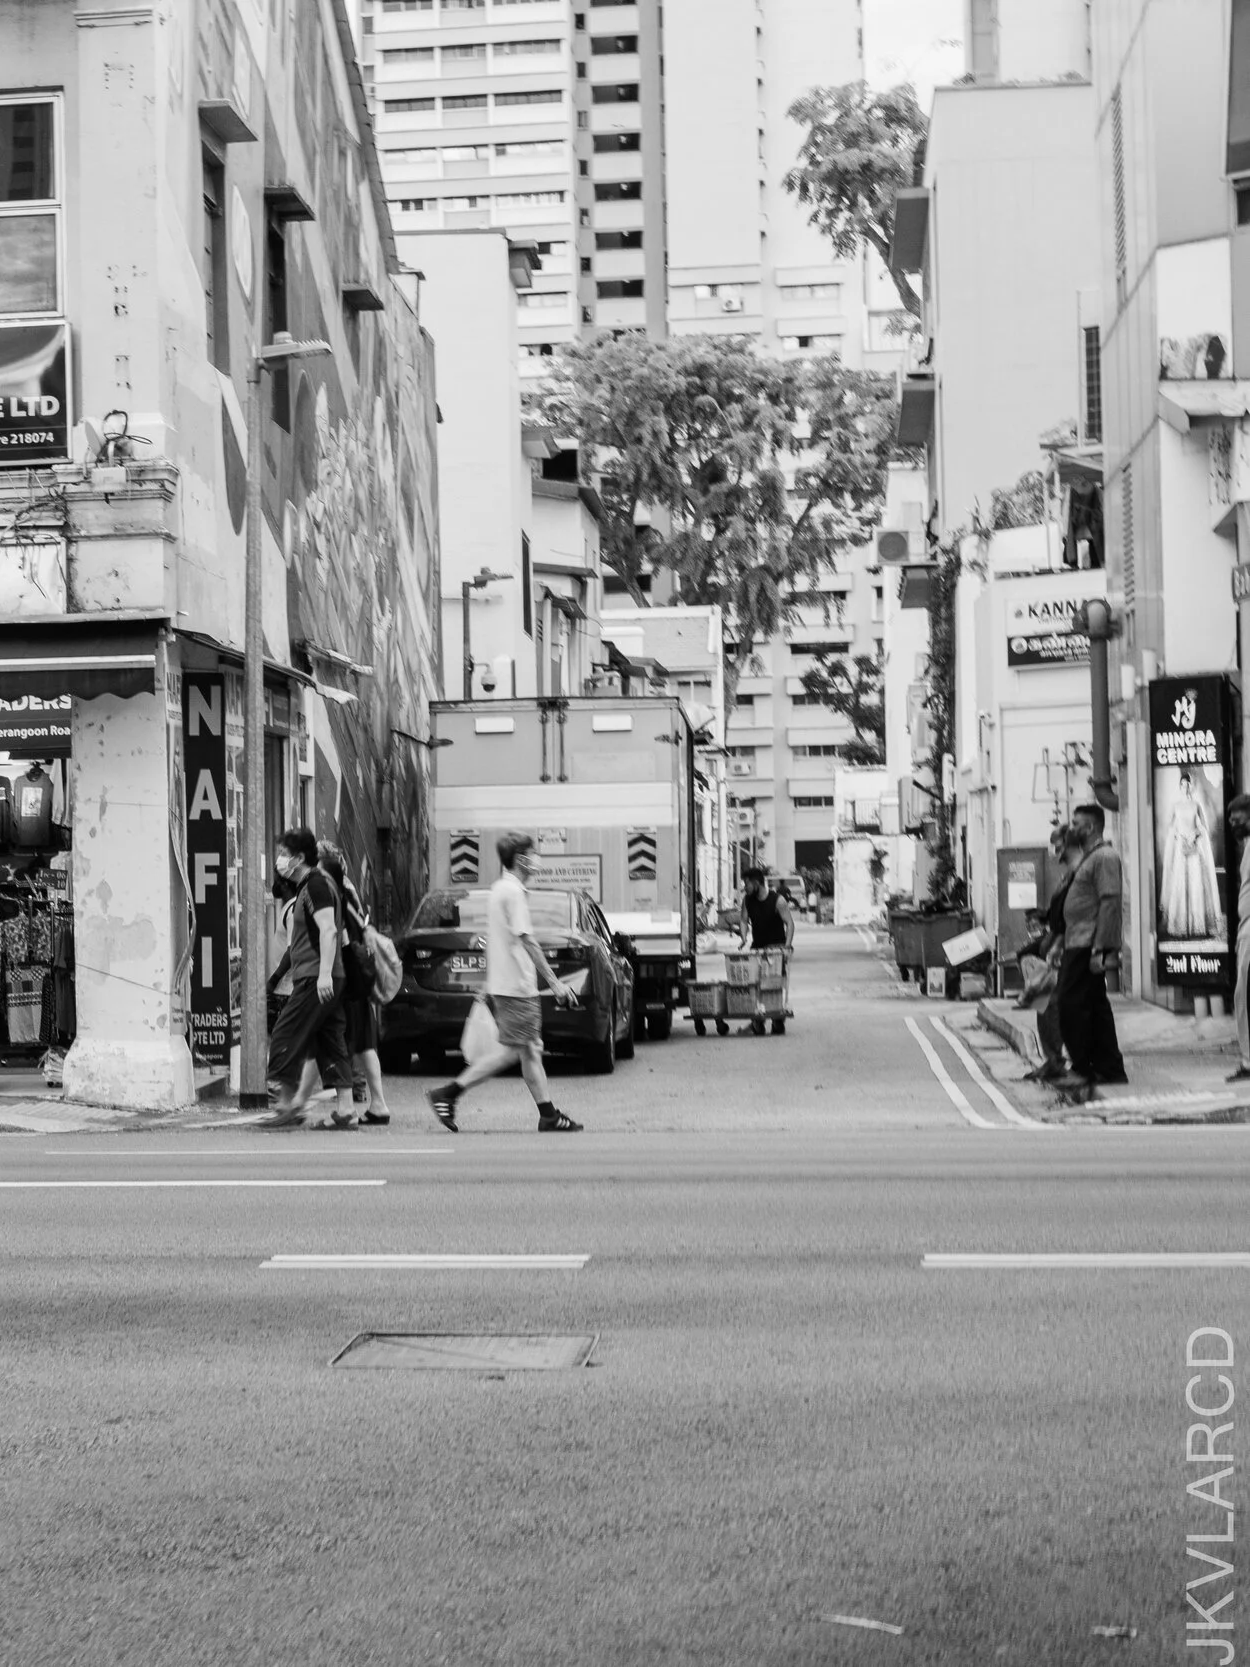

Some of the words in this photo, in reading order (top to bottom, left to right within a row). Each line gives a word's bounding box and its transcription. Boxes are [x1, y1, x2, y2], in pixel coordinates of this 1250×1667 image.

[11, 395, 61, 418] LTD
[10, 431, 54, 445] 218074
[1028, 599, 1078, 618] KANN
[50, 725, 71, 735] Roa
[1155, 729, 1217, 749] MINORA
[1156, 745, 1217, 765] CENTRE
[1166, 954, 1187, 973] 2nd
[1190, 954, 1221, 973] Floor
[210, 1031, 226, 1045] LTD
